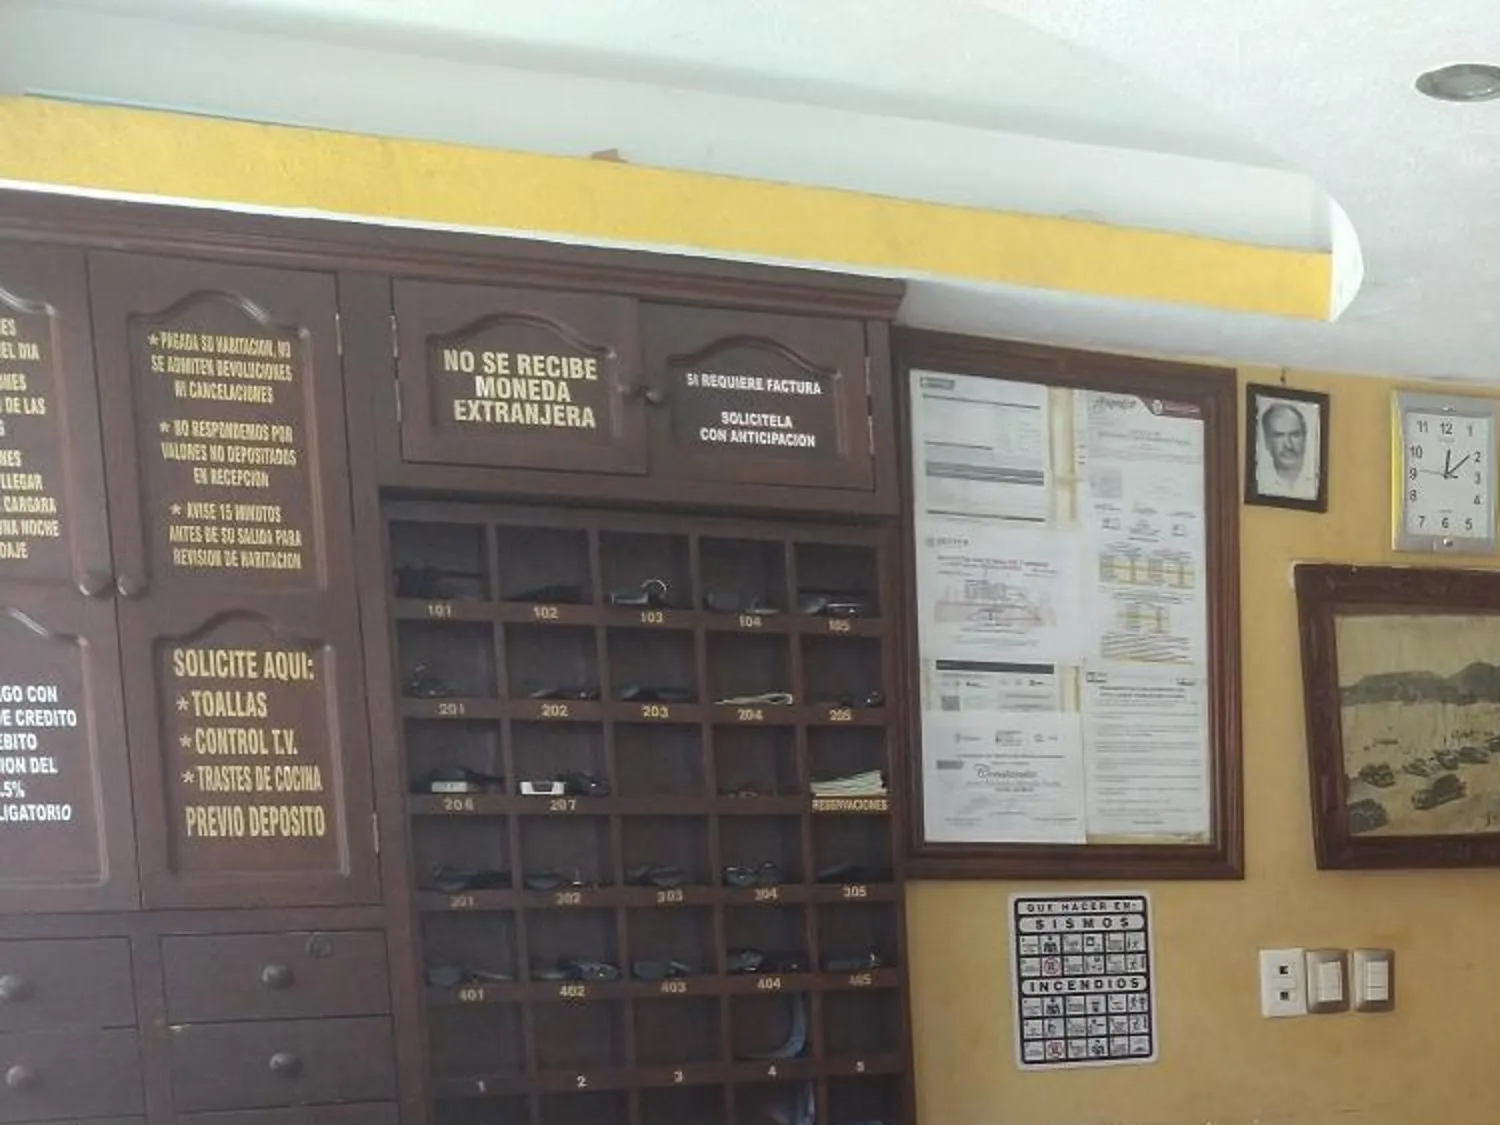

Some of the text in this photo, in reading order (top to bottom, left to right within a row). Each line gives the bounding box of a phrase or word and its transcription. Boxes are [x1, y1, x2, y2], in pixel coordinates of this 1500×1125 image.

[151, 356, 165, 373] SE
[443, 349, 598, 382] NO SE RECIBE
[189, 382, 274, 403] CANCELACIONES
[474, 375, 571, 403] MONEDA
[687, 372, 822, 396] SI REQUIERE FACTURA
[5, 397, 46, 415] DE LAS
[454, 401, 596, 428] EXTRANJERA
[720, 411, 793, 428] SOLICITELA
[1416, 420, 1453, 435] 11 12
[191, 420, 269, 441] RESPONDEMOS
[270, 424, 293, 443] POR
[700, 427, 816, 448] CON ANTICIPACION
[161, 441, 207, 461] VALORES
[208, 444, 225, 463] NO
[1410, 445, 1423, 459] 10
[220, 504, 234, 522] 15
[169, 525, 203, 544] ANTES
[204, 525, 219, 544] DE
[275, 529, 302, 548] PARA
[534, 606, 559, 621] 102
[640, 610, 664, 624] 103
[173, 648, 315, 681] SOLICITE AQUI:
[27, 686, 58, 702] CON
[192, 690, 268, 718] TOALLAS
[541, 703, 569, 719] 202
[643, 704, 669, 719] 203
[15, 709, 77, 727] CREDITO
[195, 728, 298, 756] CONTROL T.V.
[30, 757, 58, 773] DEL
[198, 766, 323, 792] TRASTES DE COCINA
[185, 806, 326, 837] PREVIO DEPOSITO
[1062, 901, 1107, 911] HACER
[1036, 917, 1129, 930] SISMOS
[559, 984, 586, 998] 402
[757, 976, 781, 990] 404
[1030, 978, 1140, 992] INCENDIOS
[577, 1075, 587, 1088] 2
[674, 1070, 684, 1083] 3
